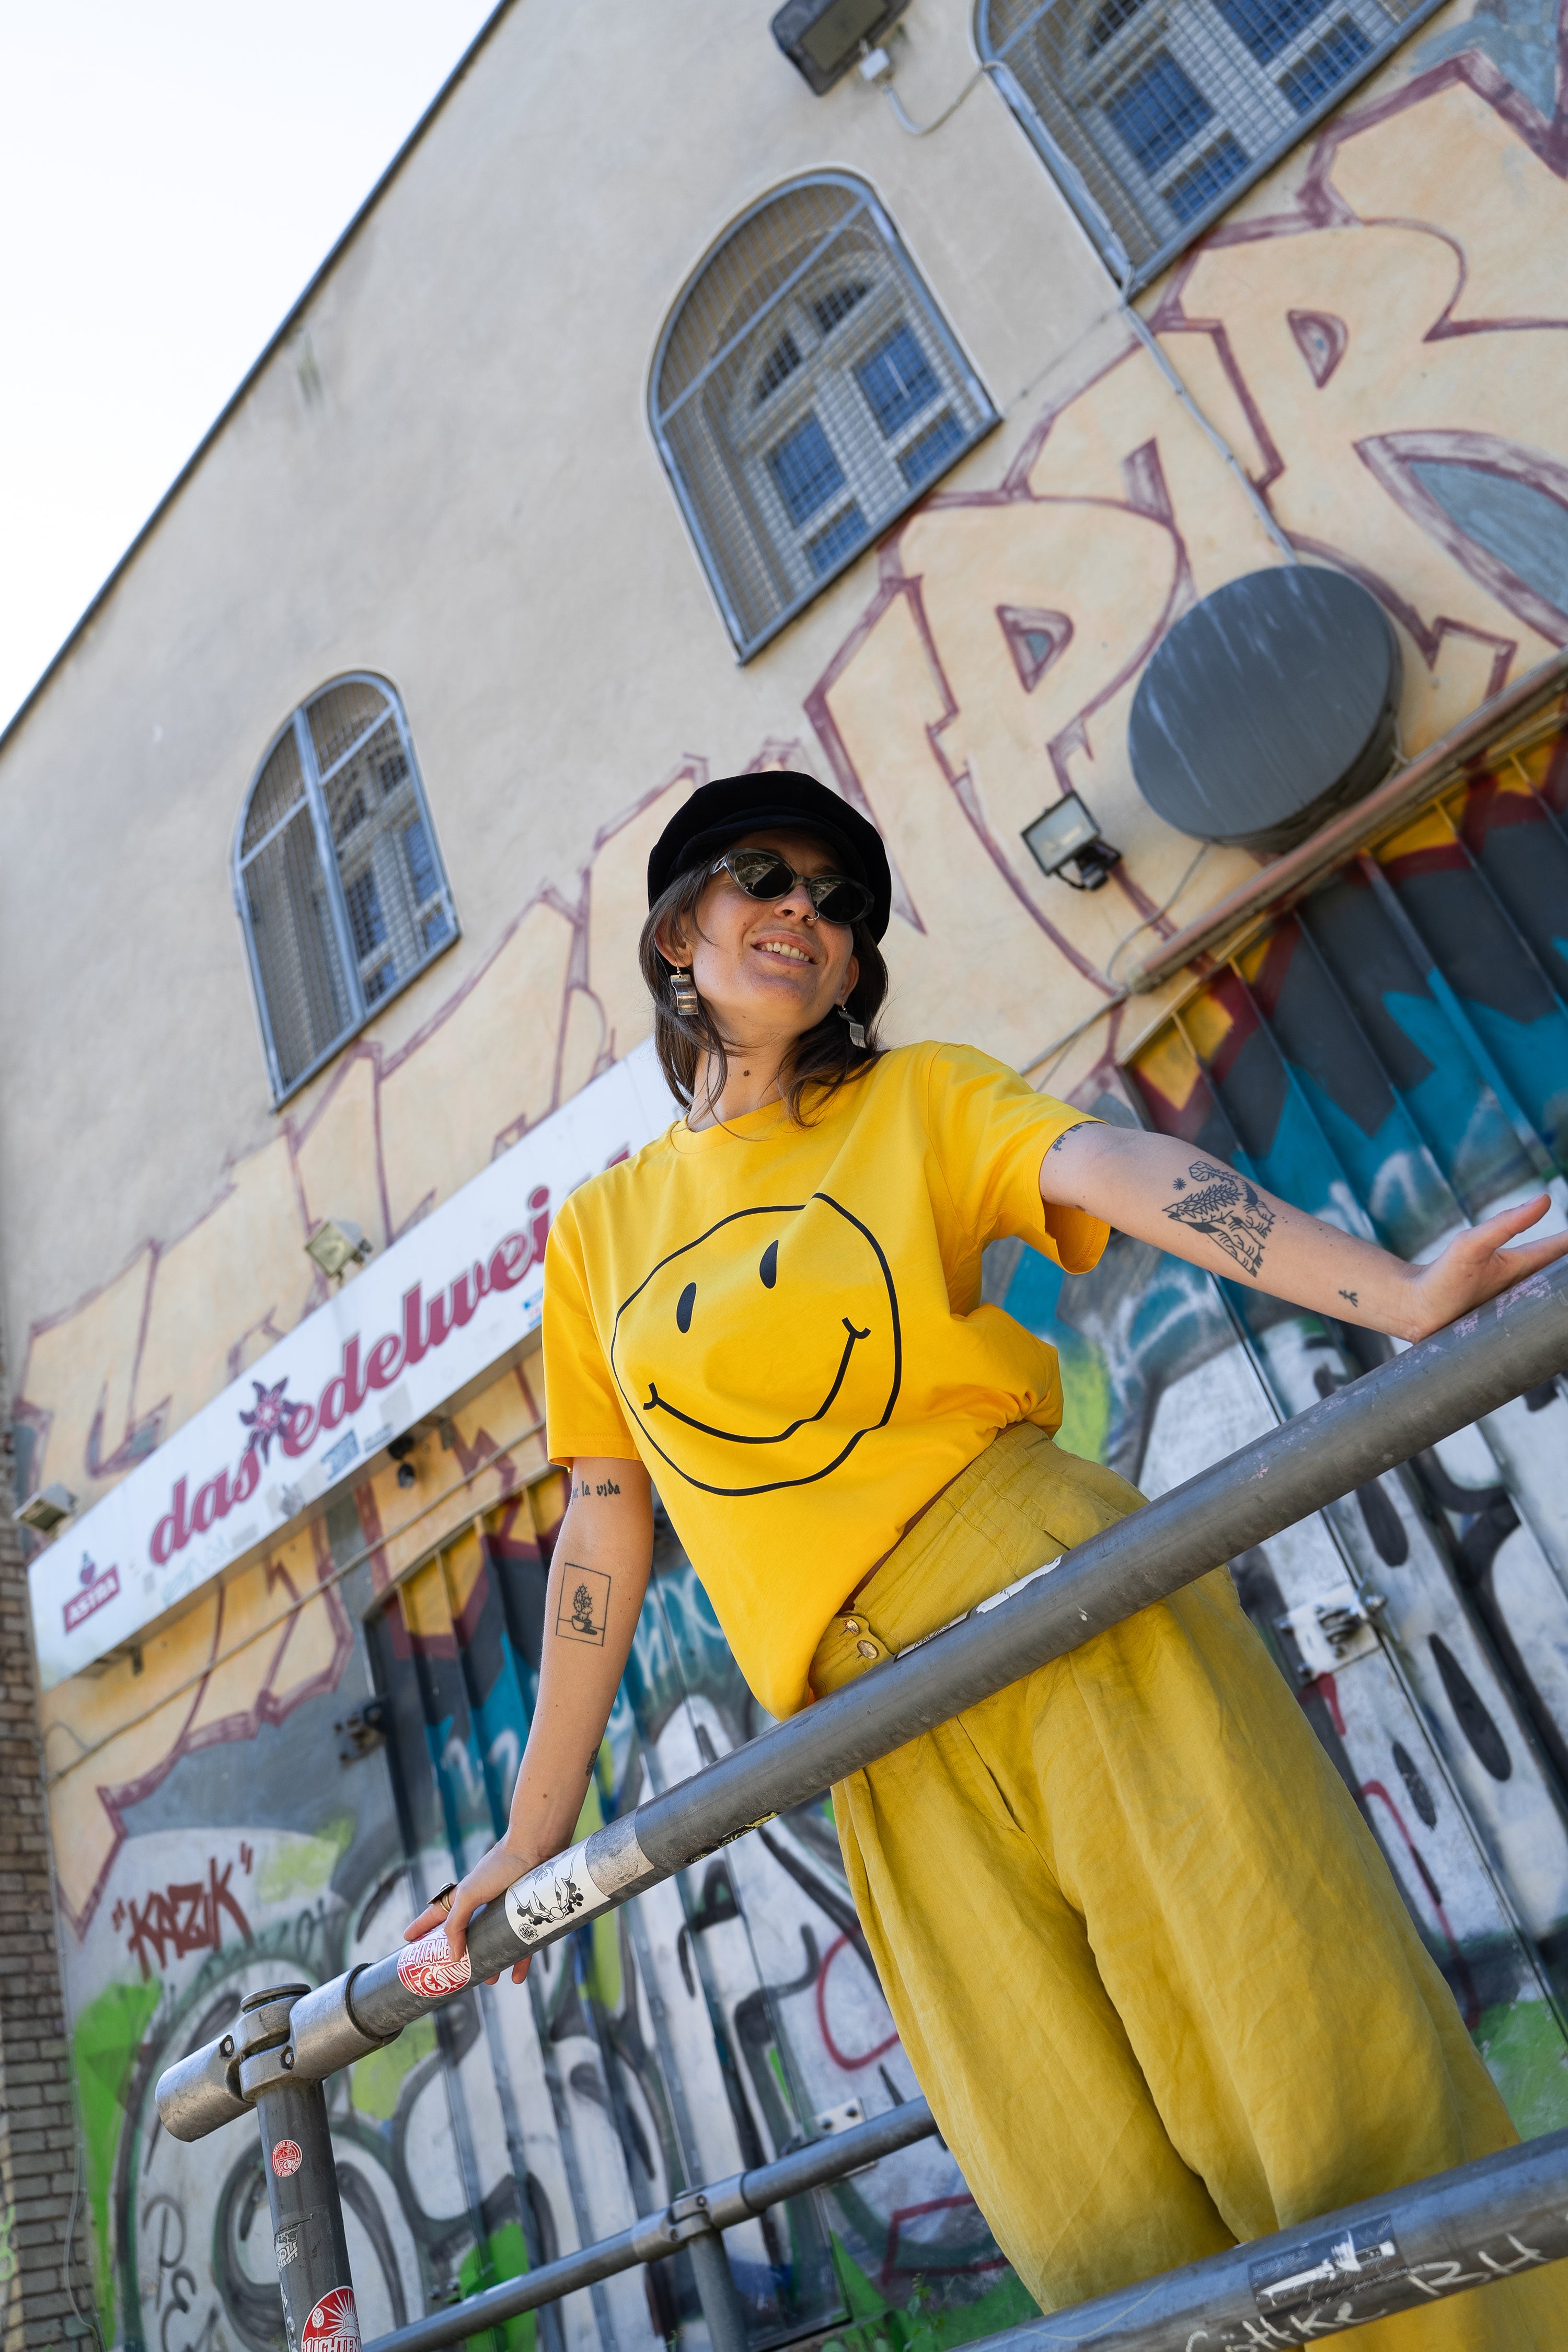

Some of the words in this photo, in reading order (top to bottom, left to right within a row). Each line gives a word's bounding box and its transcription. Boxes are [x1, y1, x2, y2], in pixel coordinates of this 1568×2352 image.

[150, 1448, 260, 1565] das
[281, 1145, 630, 1458] edelwei
[581, 1480, 591, 1496] la
[596, 1479, 620, 1496] vida
[68, 1573, 118, 1623] ASTRA
[399, 1938, 451, 1966] LICHTENBE
